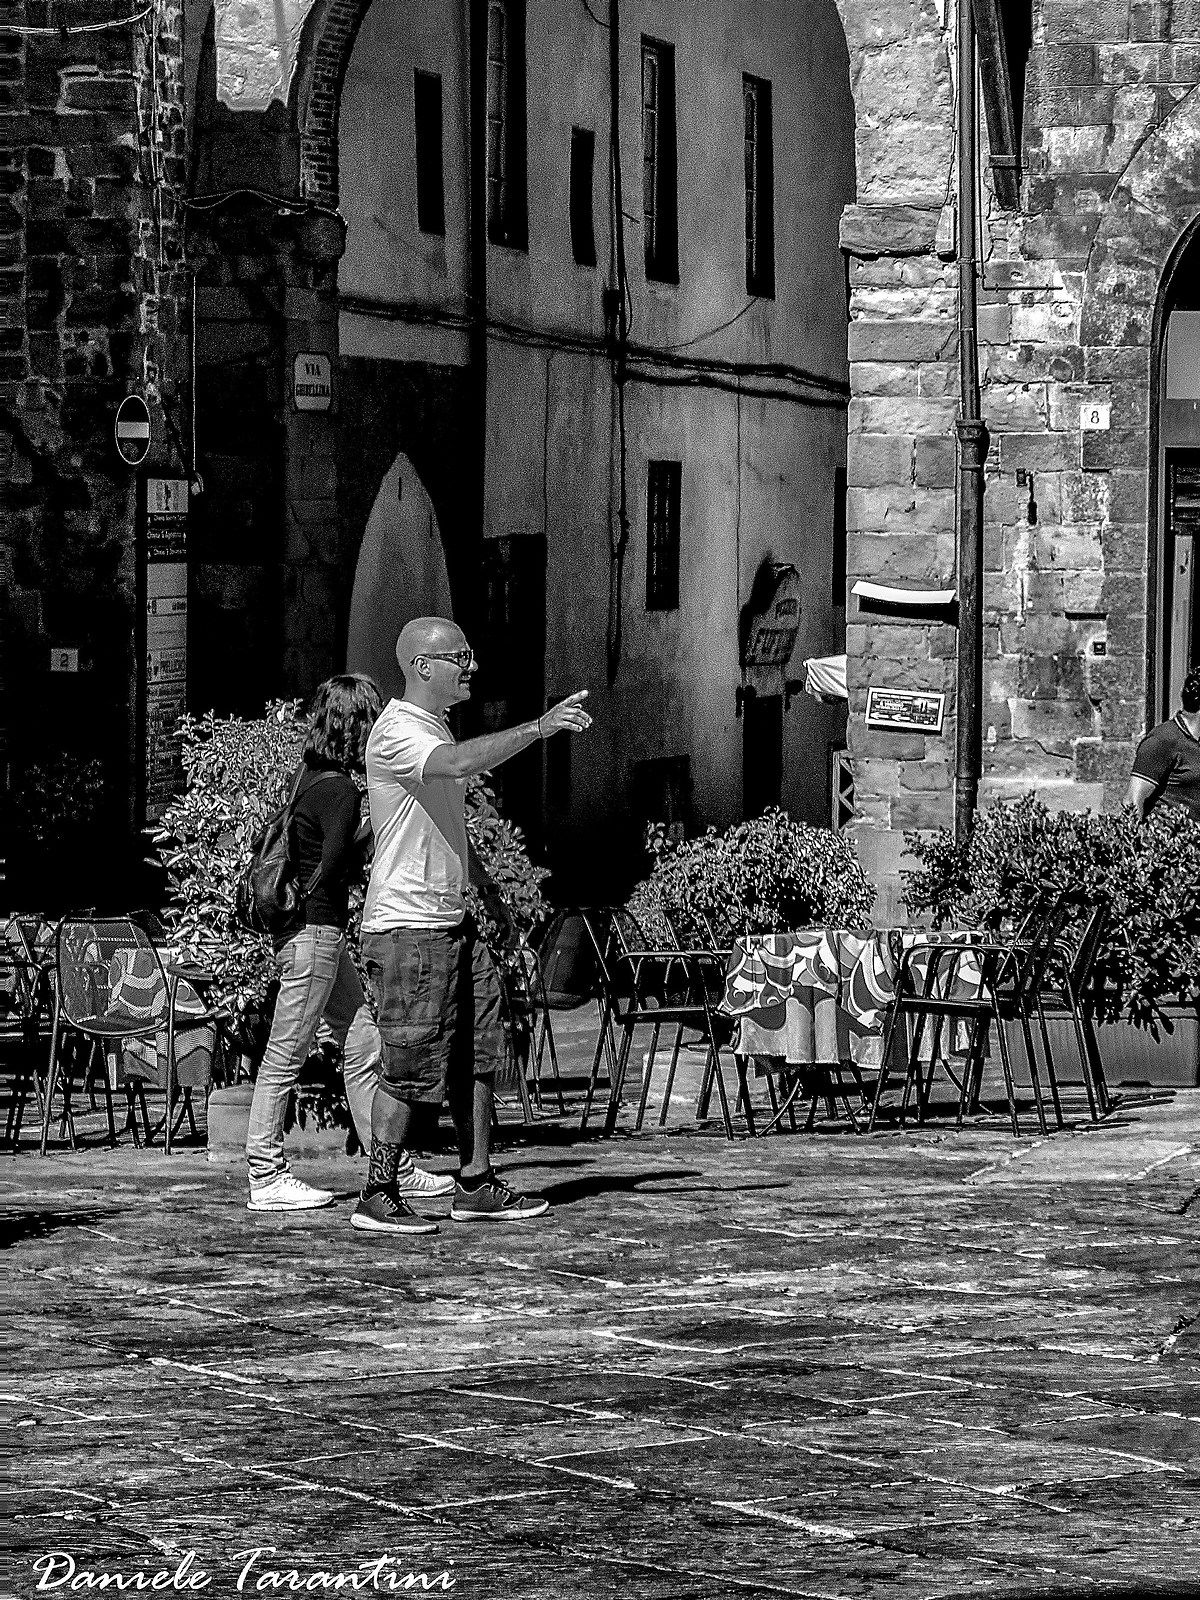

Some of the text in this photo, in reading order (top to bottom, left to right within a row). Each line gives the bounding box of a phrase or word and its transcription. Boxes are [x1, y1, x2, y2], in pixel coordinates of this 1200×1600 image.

[305, 363, 320, 376] VIA
[1090, 410, 1100, 424] 8
[60, 653, 68, 667] 2
